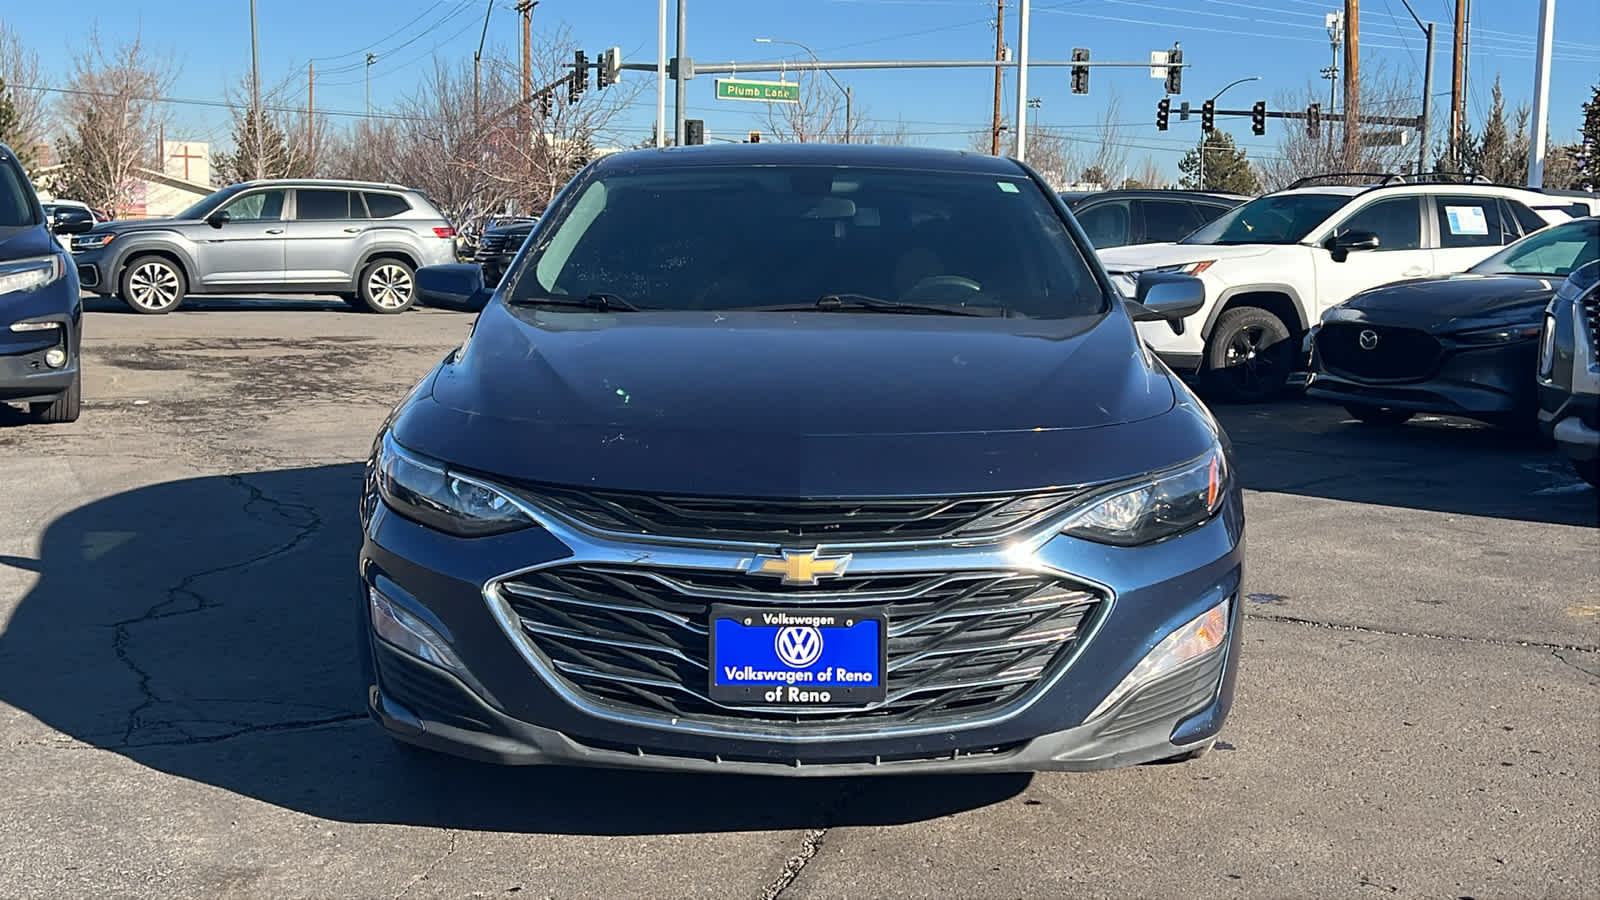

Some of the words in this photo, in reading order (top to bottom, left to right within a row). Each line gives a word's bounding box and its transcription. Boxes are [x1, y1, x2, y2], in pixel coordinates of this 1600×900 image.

[728, 86, 760, 97] Plumb
[765, 87, 790, 98] Lane
[762, 613, 835, 627] Volkswagen
[724, 666, 813, 684] Volkswagen
[817, 667, 833, 682] of
[836, 668, 873, 682] Reno
[765, 687, 783, 702] of
[788, 687, 831, 703] Reno
